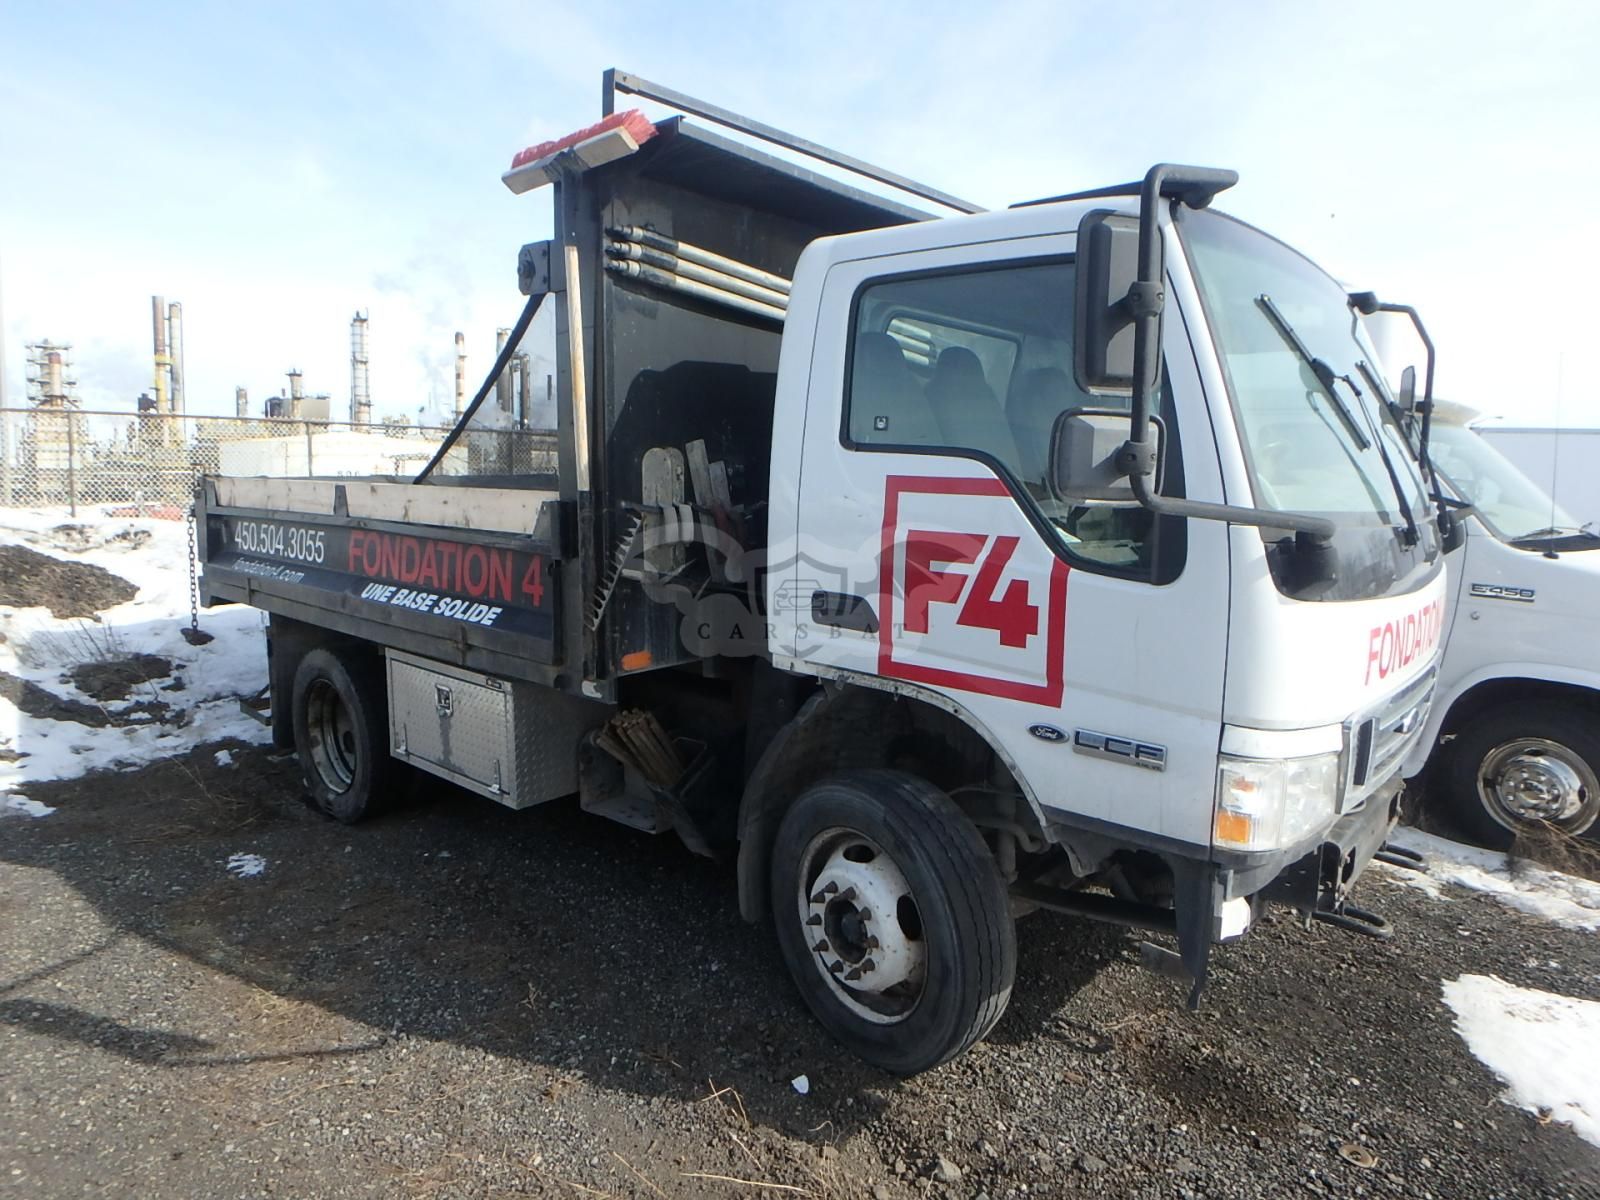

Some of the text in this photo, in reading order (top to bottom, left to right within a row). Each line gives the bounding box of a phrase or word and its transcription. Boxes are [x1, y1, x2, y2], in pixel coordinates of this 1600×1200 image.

[234, 521, 325, 564] 450.504.3055
[350, 530, 544, 607] FONDATION 4
[903, 529, 1039, 648] F4
[360, 582, 503, 626] UNE BASE SOLIDE
[1034, 727, 1059, 740] Ford
[1074, 730, 1163, 759] LCF
